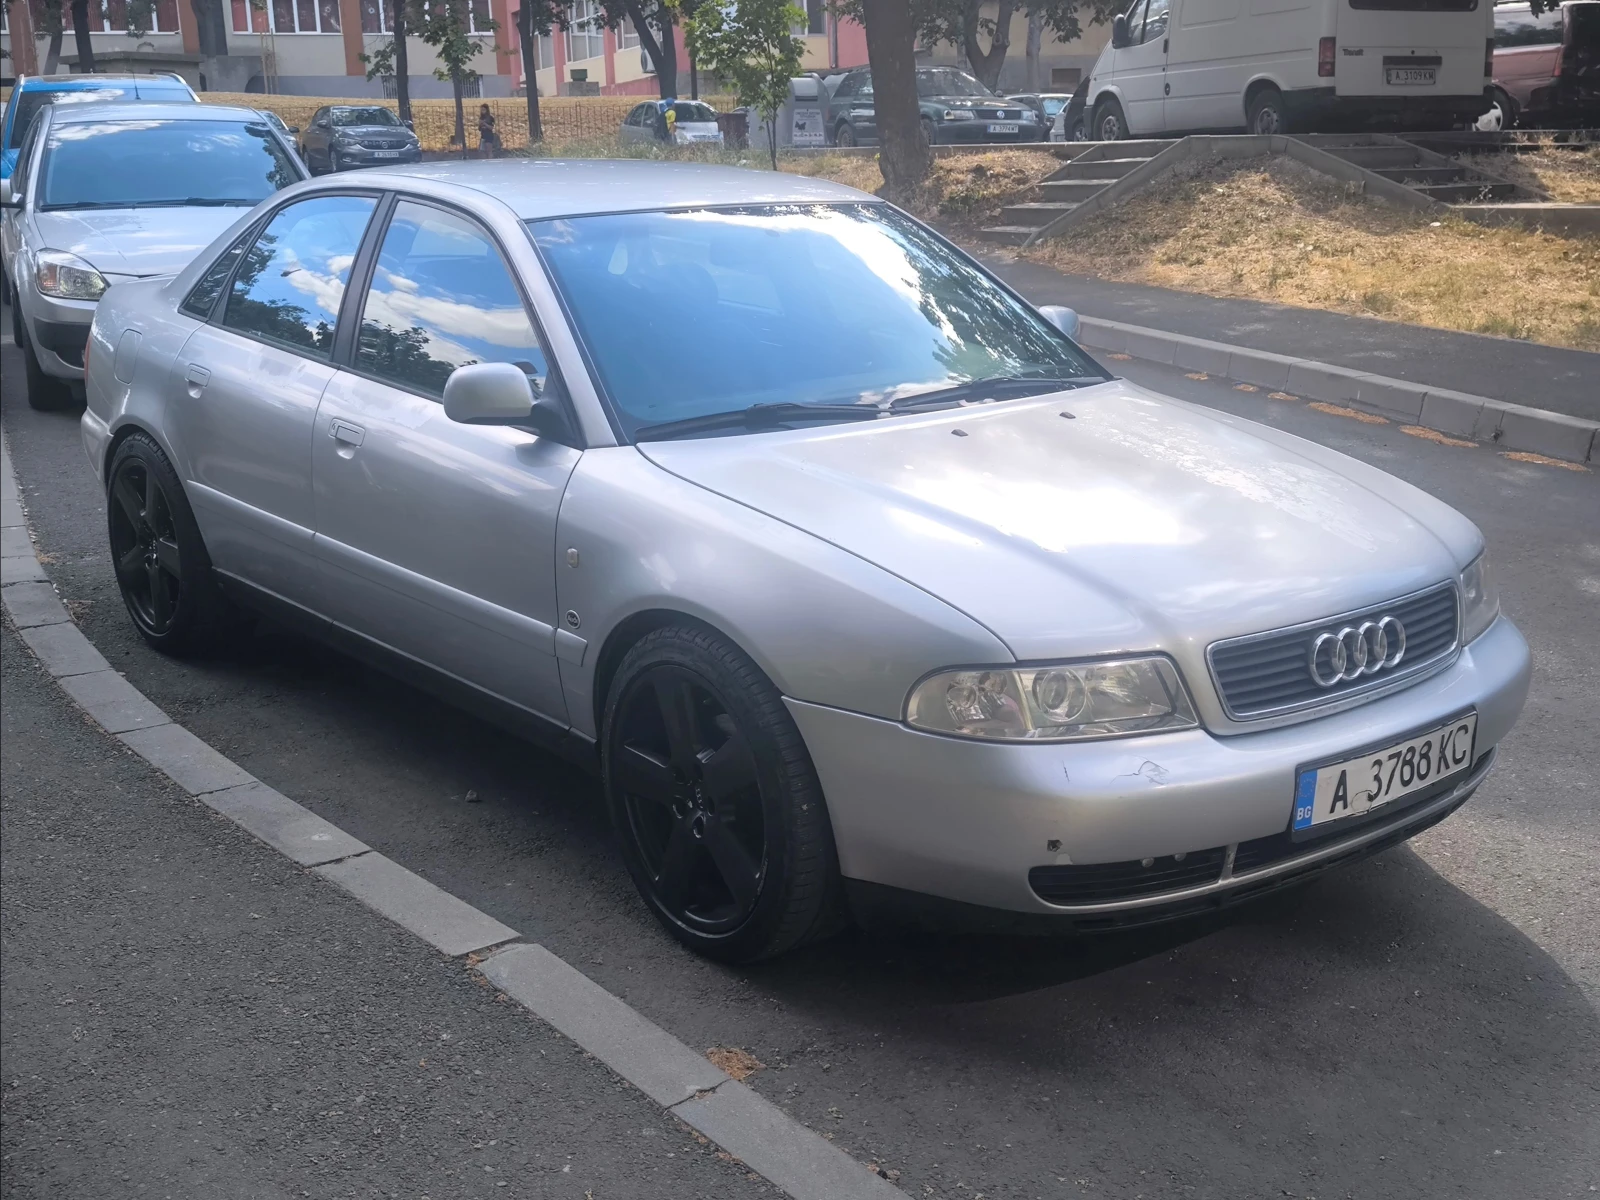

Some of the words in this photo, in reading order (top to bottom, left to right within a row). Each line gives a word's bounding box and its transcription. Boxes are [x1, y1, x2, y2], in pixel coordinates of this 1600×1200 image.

[1329, 769, 1348, 814] A
[1367, 740, 1433, 802] 3788
[1437, 724, 1469, 775] KC
[1296, 806, 1312, 821] BG
